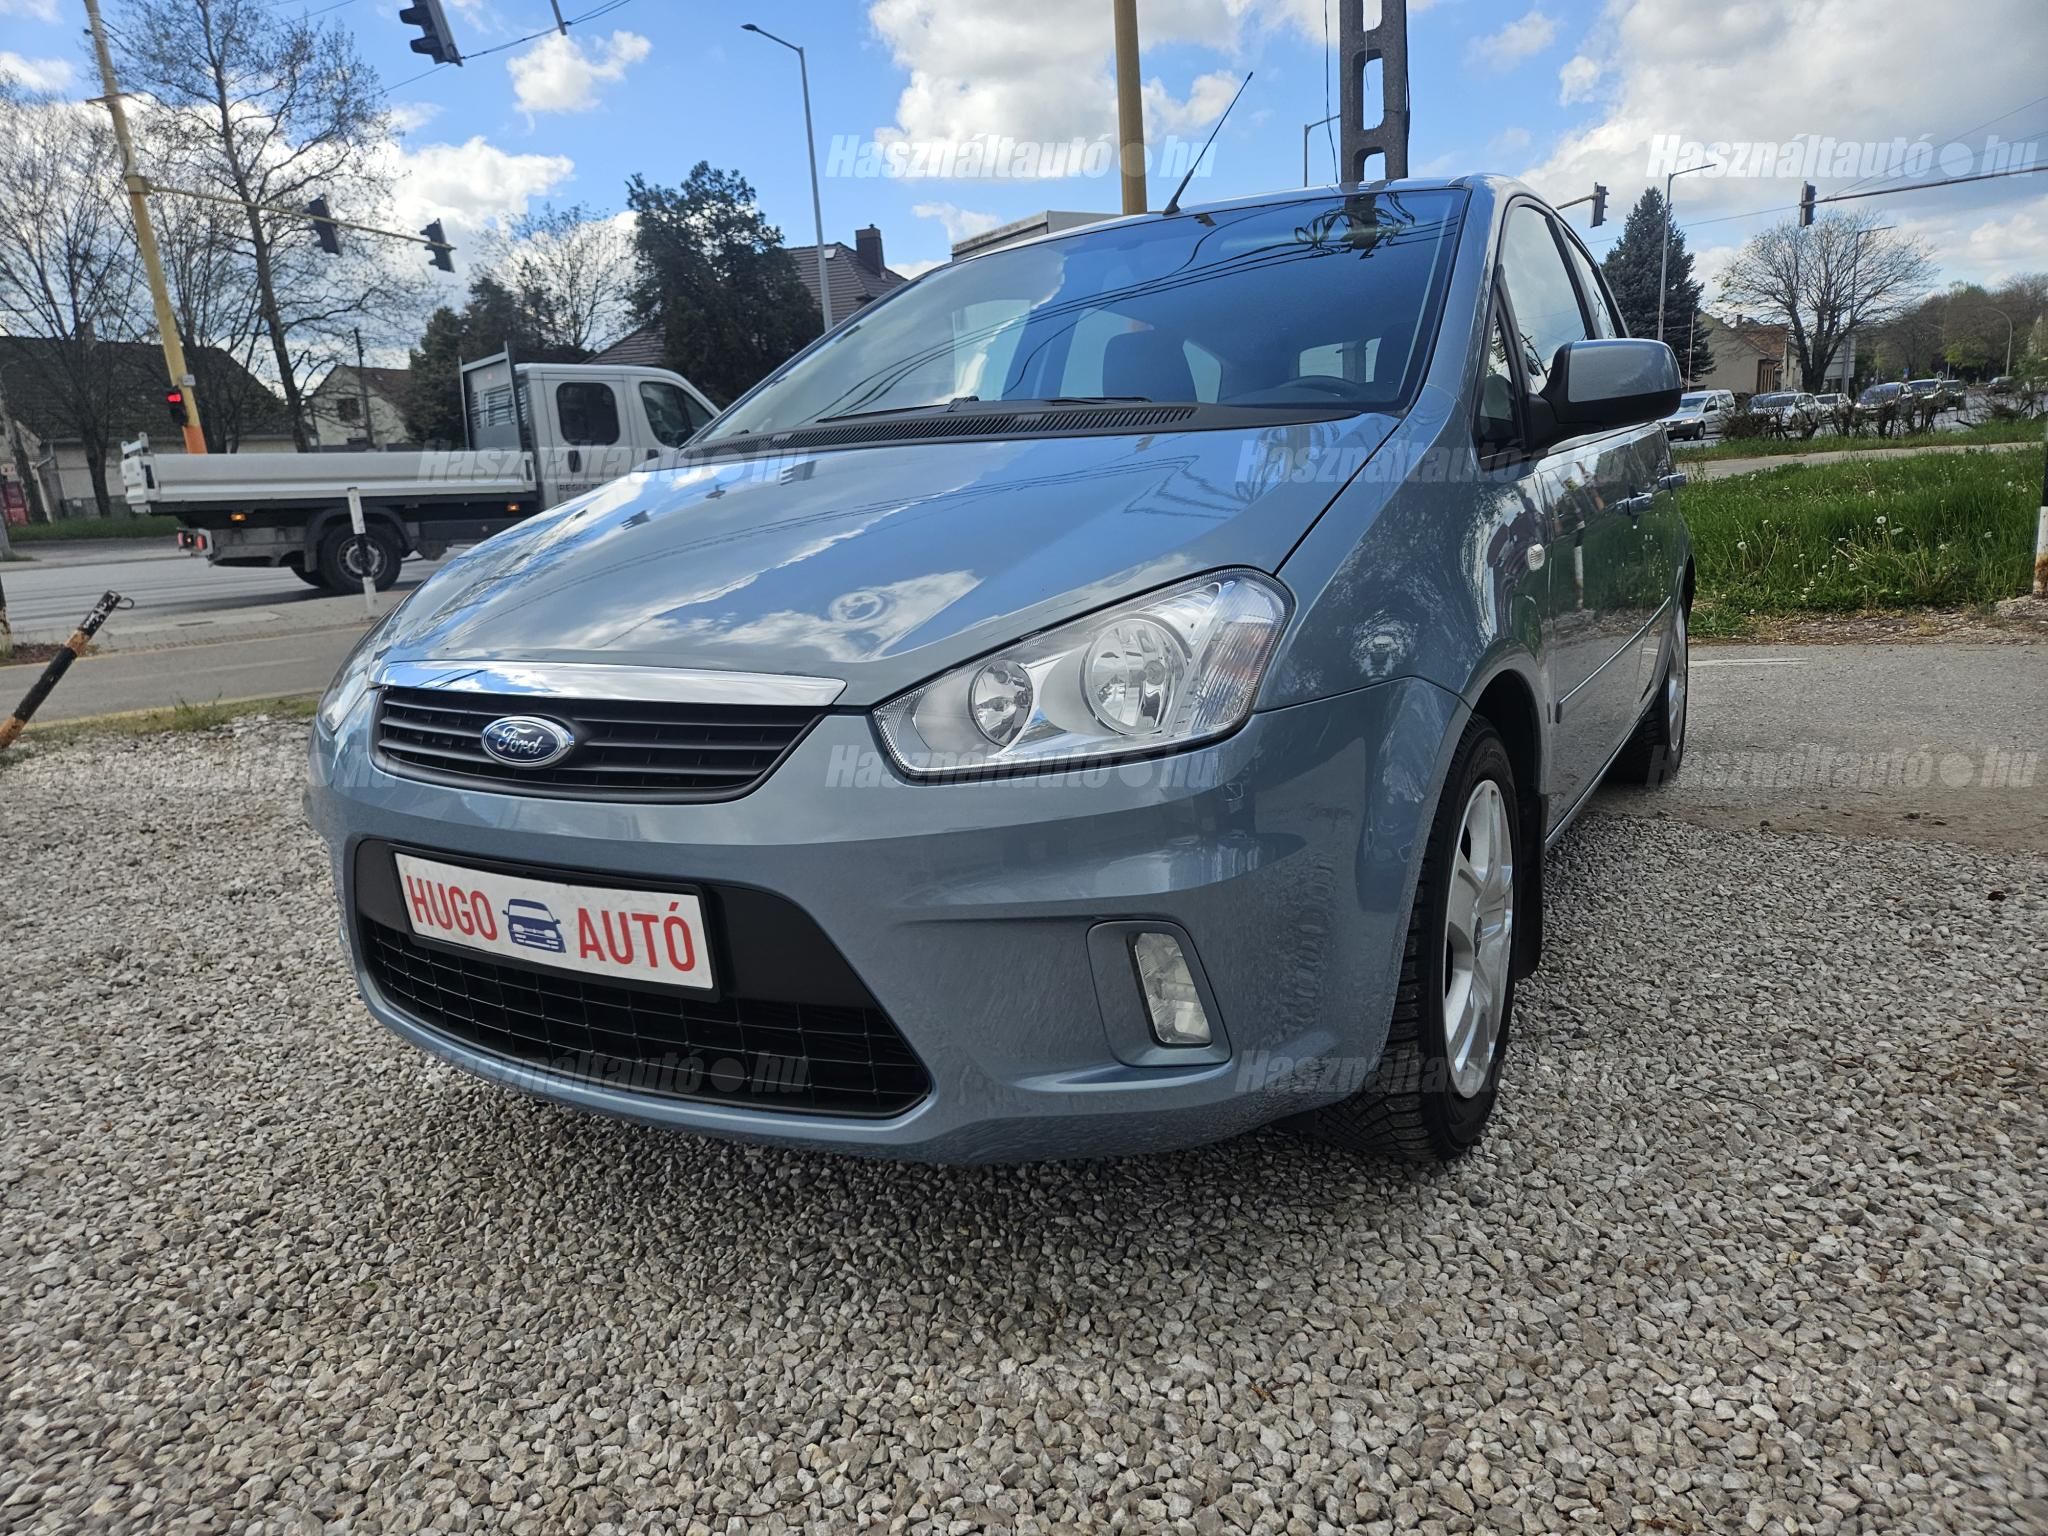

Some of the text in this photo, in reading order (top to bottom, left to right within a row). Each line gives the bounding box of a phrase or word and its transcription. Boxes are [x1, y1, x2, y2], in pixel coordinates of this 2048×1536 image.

[496, 726, 543, 755] Ford
[406, 875, 697, 972] HUGO AUTÓ
